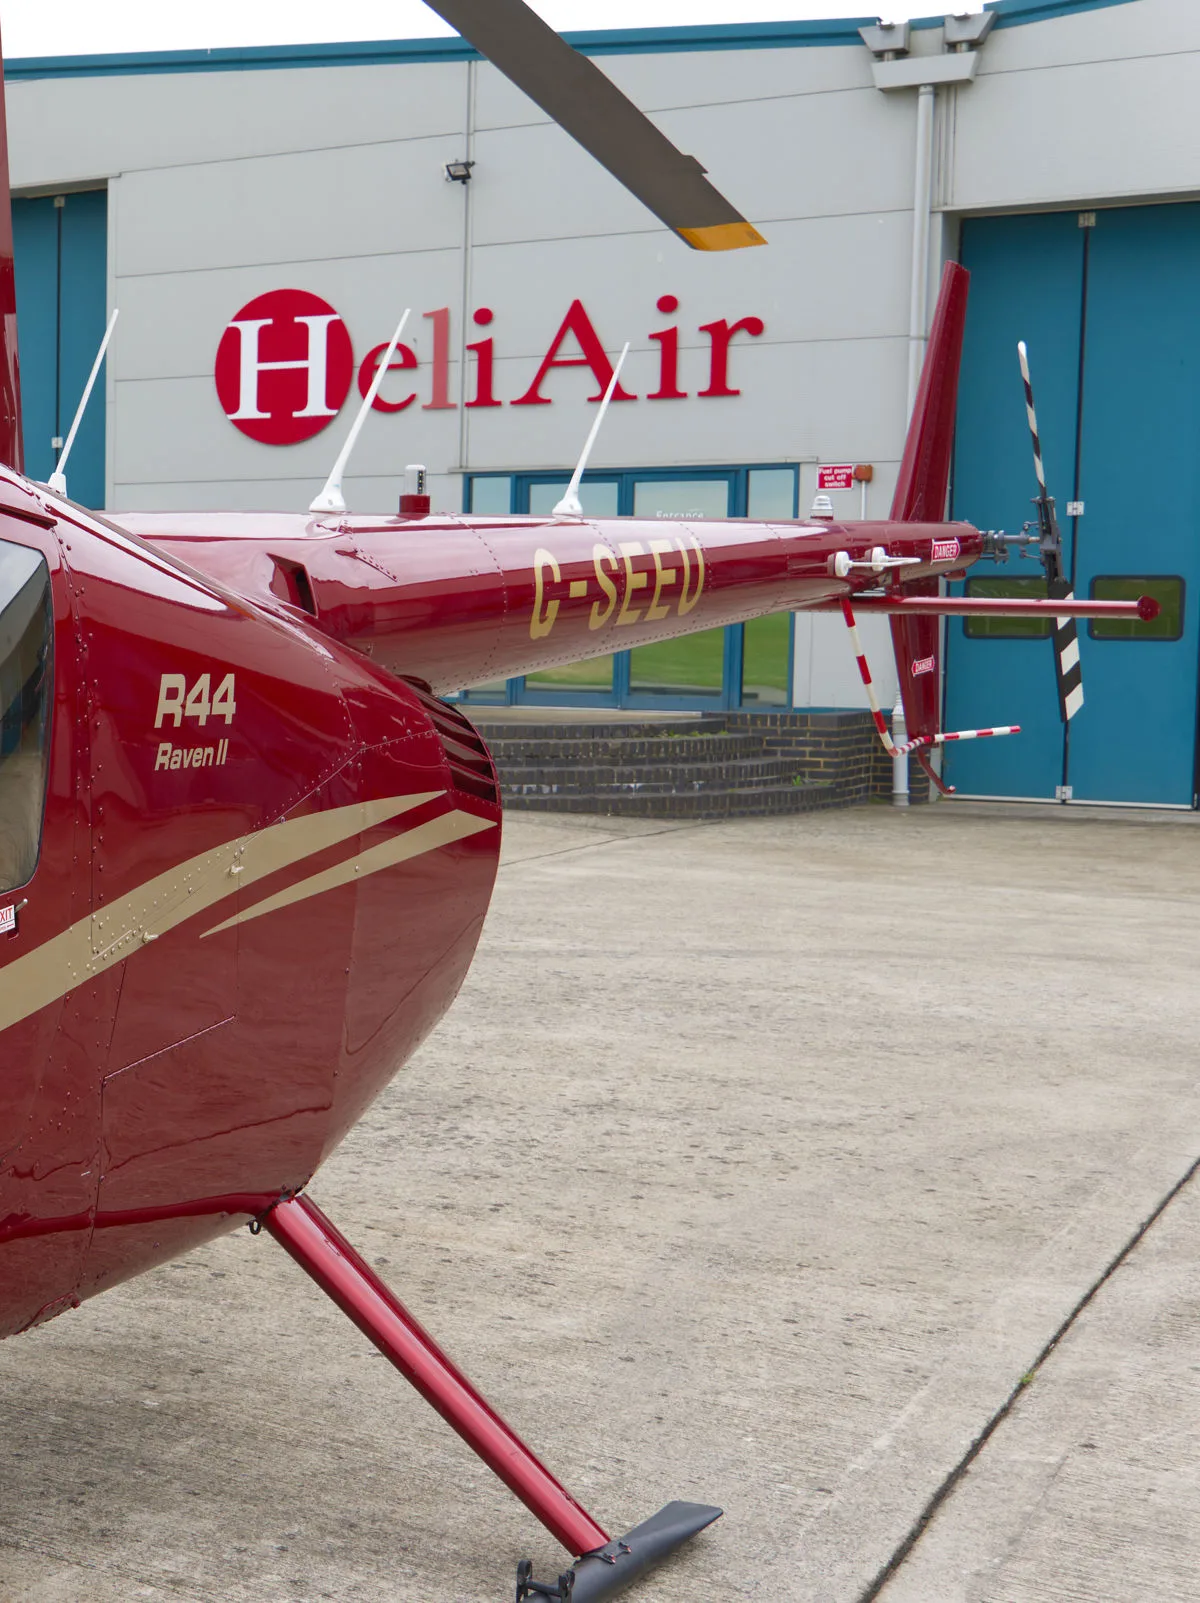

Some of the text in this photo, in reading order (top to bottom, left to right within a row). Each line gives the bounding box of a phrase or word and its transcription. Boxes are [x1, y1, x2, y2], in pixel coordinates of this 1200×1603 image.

[819, 467, 834, 475] Fuel
[934, 544, 958, 558] DANGER
[529, 536, 706, 641] G-SEEU
[915, 659, 933, 672] DANGER
[153, 673, 237, 729] R44
[154, 742, 214, 771] Raven
